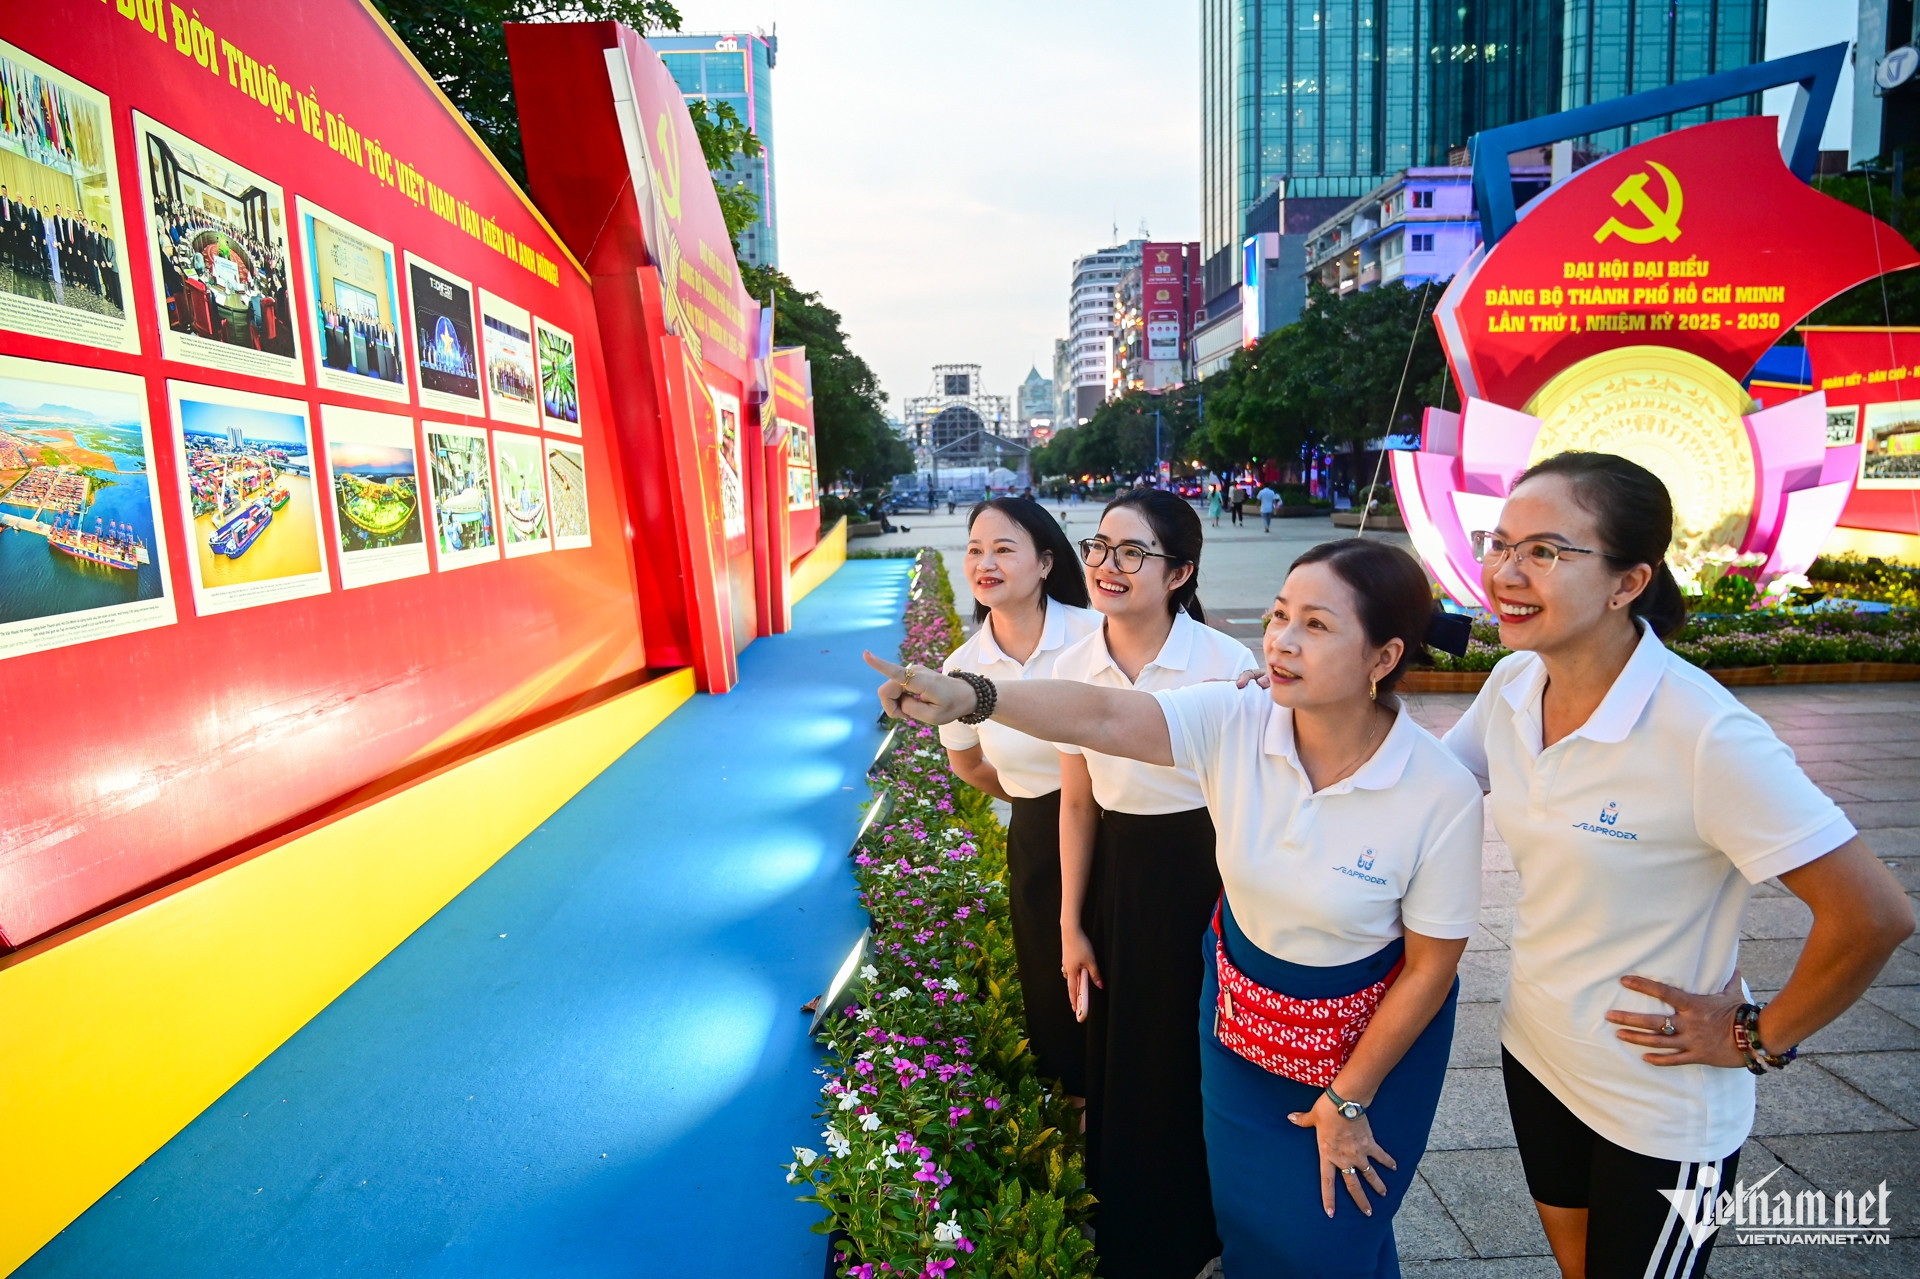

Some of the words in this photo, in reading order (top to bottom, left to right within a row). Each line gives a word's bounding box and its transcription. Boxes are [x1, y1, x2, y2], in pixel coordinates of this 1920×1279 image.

[170, 2, 220, 76] ĐỜI
[221, 37, 295, 124] THUỘC
[296, 85, 324, 142] VỀ
[325, 110, 363, 168] DÂN
[364, 137, 394, 187] TỘC
[395, 158, 425, 207] VIỆT
[427, 180, 458, 226] NAM
[457, 200, 481, 241] VĂN
[481, 216, 505, 255] HIẾN
[505, 232, 519, 263] VÀ
[519, 241, 537, 274] ANH
[1563, 261, 1595, 281] ĐẠI
[1598, 258, 1630, 281] HỘI
[1633, 261, 1664, 280] ĐẠI
[1667, 254, 1709, 278] BIỂU
[1485, 285, 1536, 306] ĐẢNG
[1539, 286, 1564, 308] BỘ
[1567, 285, 1630, 305] THÀNH
[1633, 282, 1670, 304] PHỐ
[1673, 281, 1698, 304] HỒ
[1701, 283, 1732, 304] CHÍ
[1735, 286, 1785, 303] MINH
[1488, 310, 1526, 332] LẦN
[1529, 312, 1568, 332] THỨ
[1570, 315, 1581, 334] I,
[1585, 311, 1646, 334] NHIỆM
[1650, 311, 1675, 331] KỲ
[1678, 313, 1721, 330] 2025
[1737, 312, 1780, 330] 2030
[1572, 822, 1638, 840] SEAPRODEX
[1331, 866, 1388, 885] SEAPRODEX
